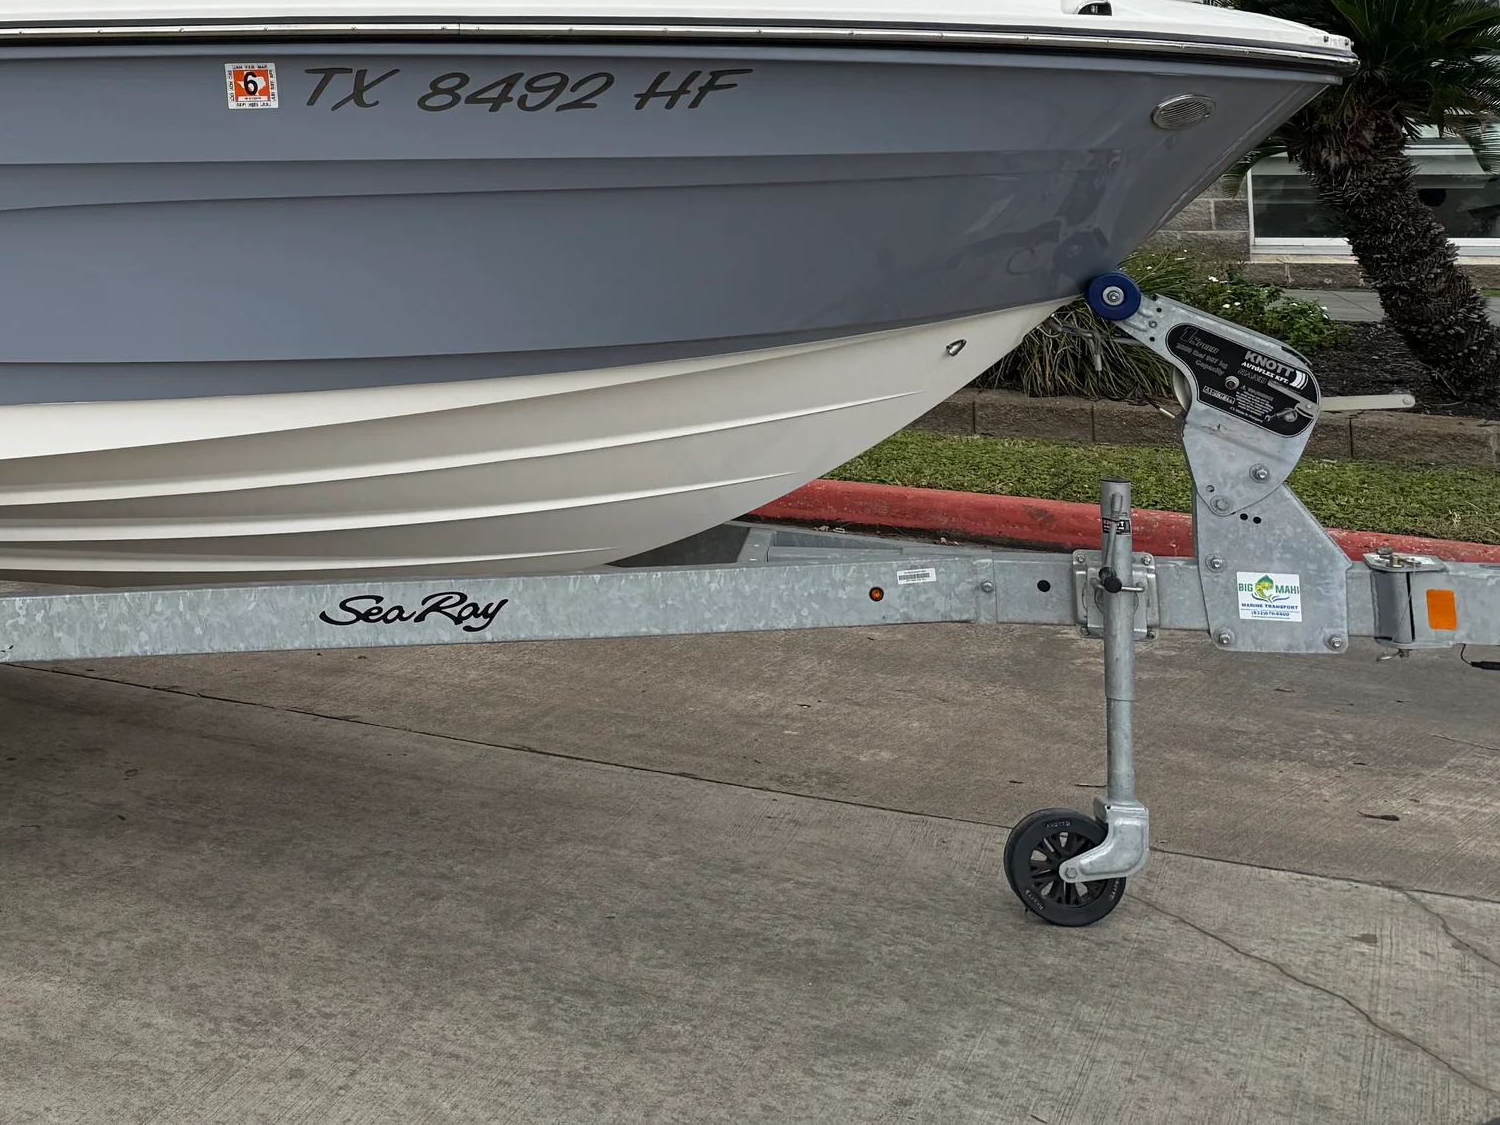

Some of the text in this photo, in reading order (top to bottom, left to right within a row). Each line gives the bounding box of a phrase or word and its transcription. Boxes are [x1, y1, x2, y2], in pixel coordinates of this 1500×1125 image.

[243, 72, 258, 96] 6
[304, 67, 400, 111] TX
[417, 71, 615, 112] 8492
[634, 68, 753, 111] HF
[1244, 350, 1294, 377] KNOTT
[1238, 583, 1300, 595] BIG MAHI
[319, 591, 509, 633] Sea Ray
